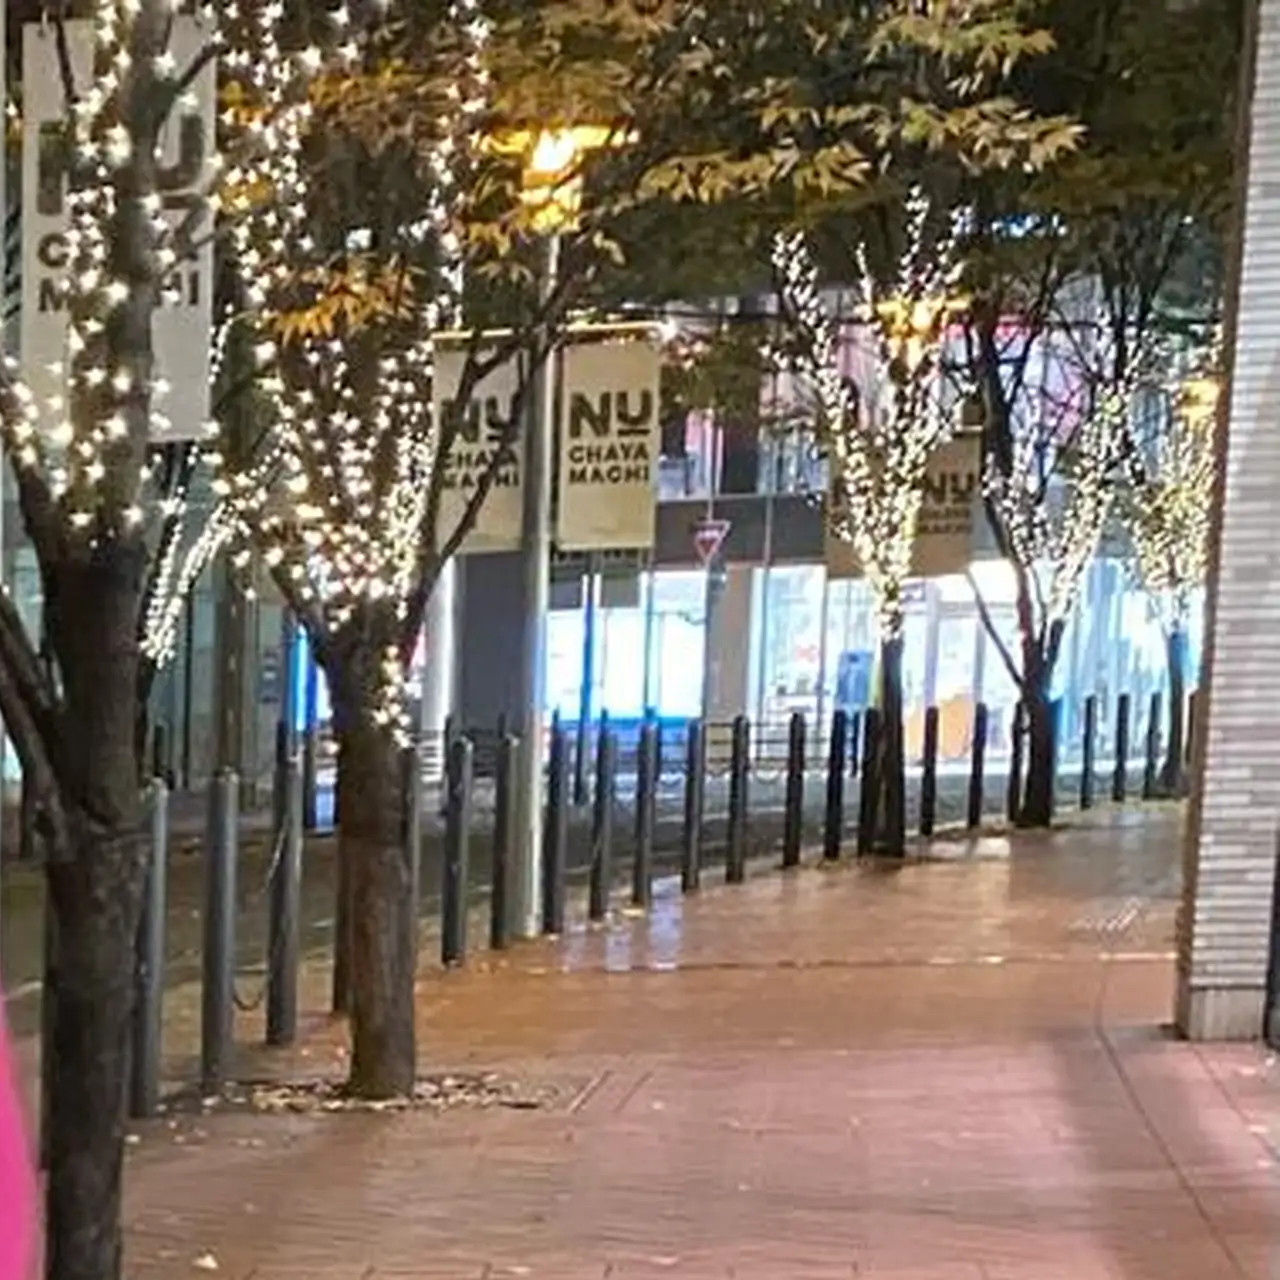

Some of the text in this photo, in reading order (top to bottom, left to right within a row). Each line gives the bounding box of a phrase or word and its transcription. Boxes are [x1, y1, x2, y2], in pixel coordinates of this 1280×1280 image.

[570, 389, 652, 438] NU
[569, 442, 648, 463] CHAYA
[569, 465, 649, 484] MACHI
